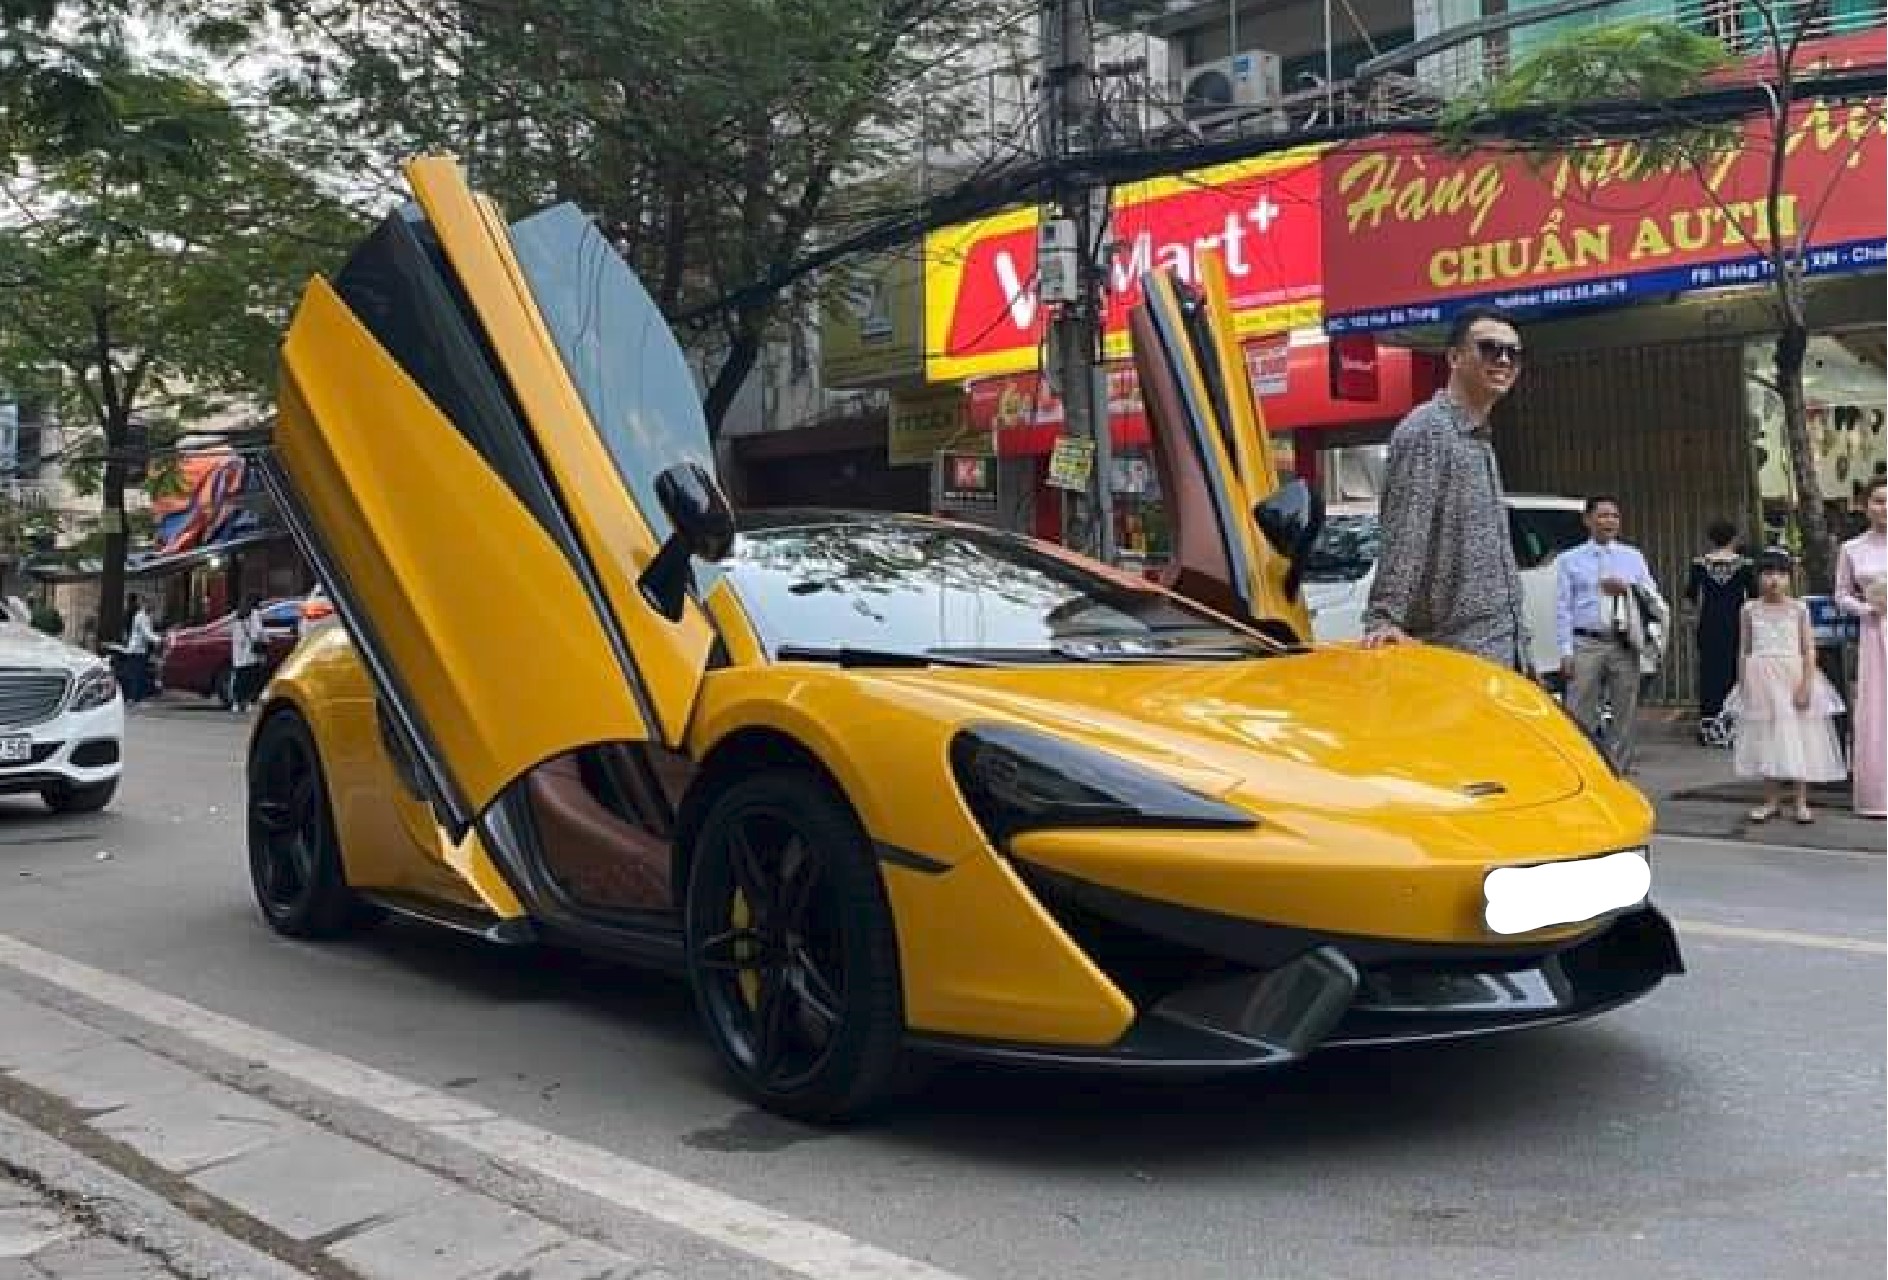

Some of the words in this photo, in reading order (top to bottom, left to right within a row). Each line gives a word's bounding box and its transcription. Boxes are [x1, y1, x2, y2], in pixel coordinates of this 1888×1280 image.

[1338, 153, 1504, 235] Hàng
[1429, 209, 1612, 287] CHUẨN
[1629, 195, 1799, 258] AUTH
